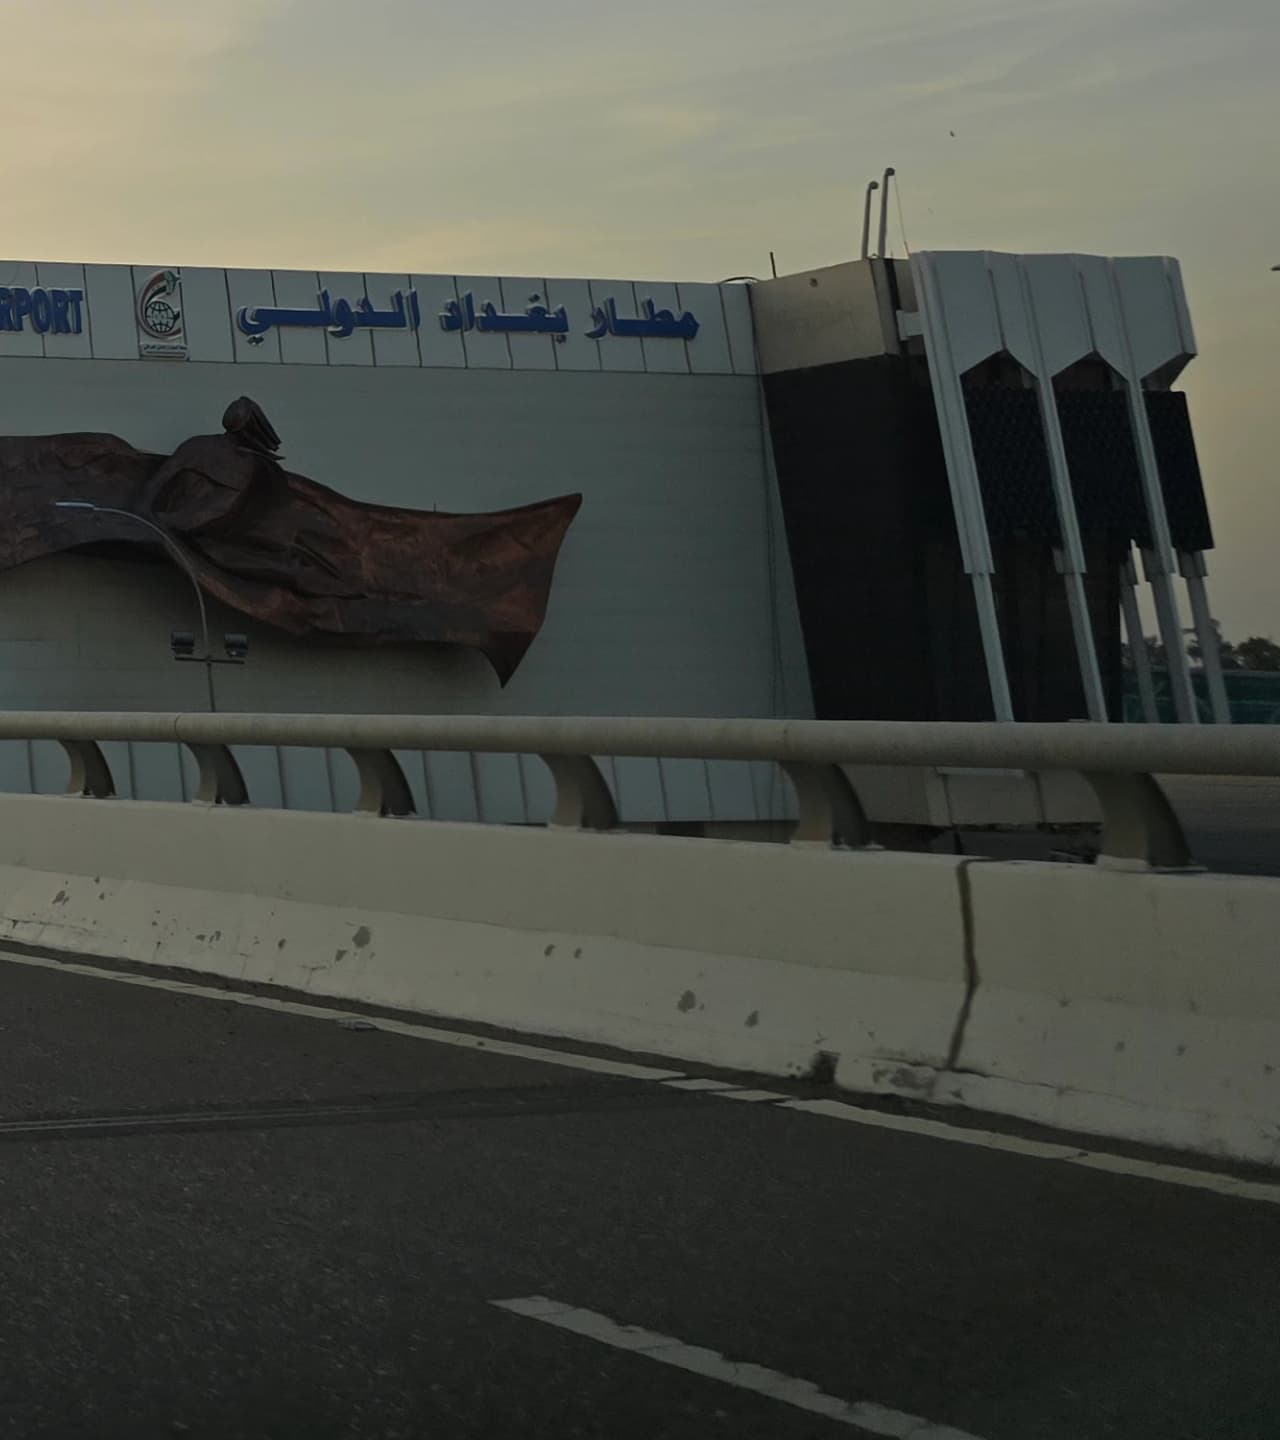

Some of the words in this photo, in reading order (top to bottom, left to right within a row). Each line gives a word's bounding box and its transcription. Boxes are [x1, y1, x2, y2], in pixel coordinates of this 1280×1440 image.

[237, 287, 421, 345] الدولي
[439, 289, 569, 343] بغداد
[584, 295, 700, 339] مطار
